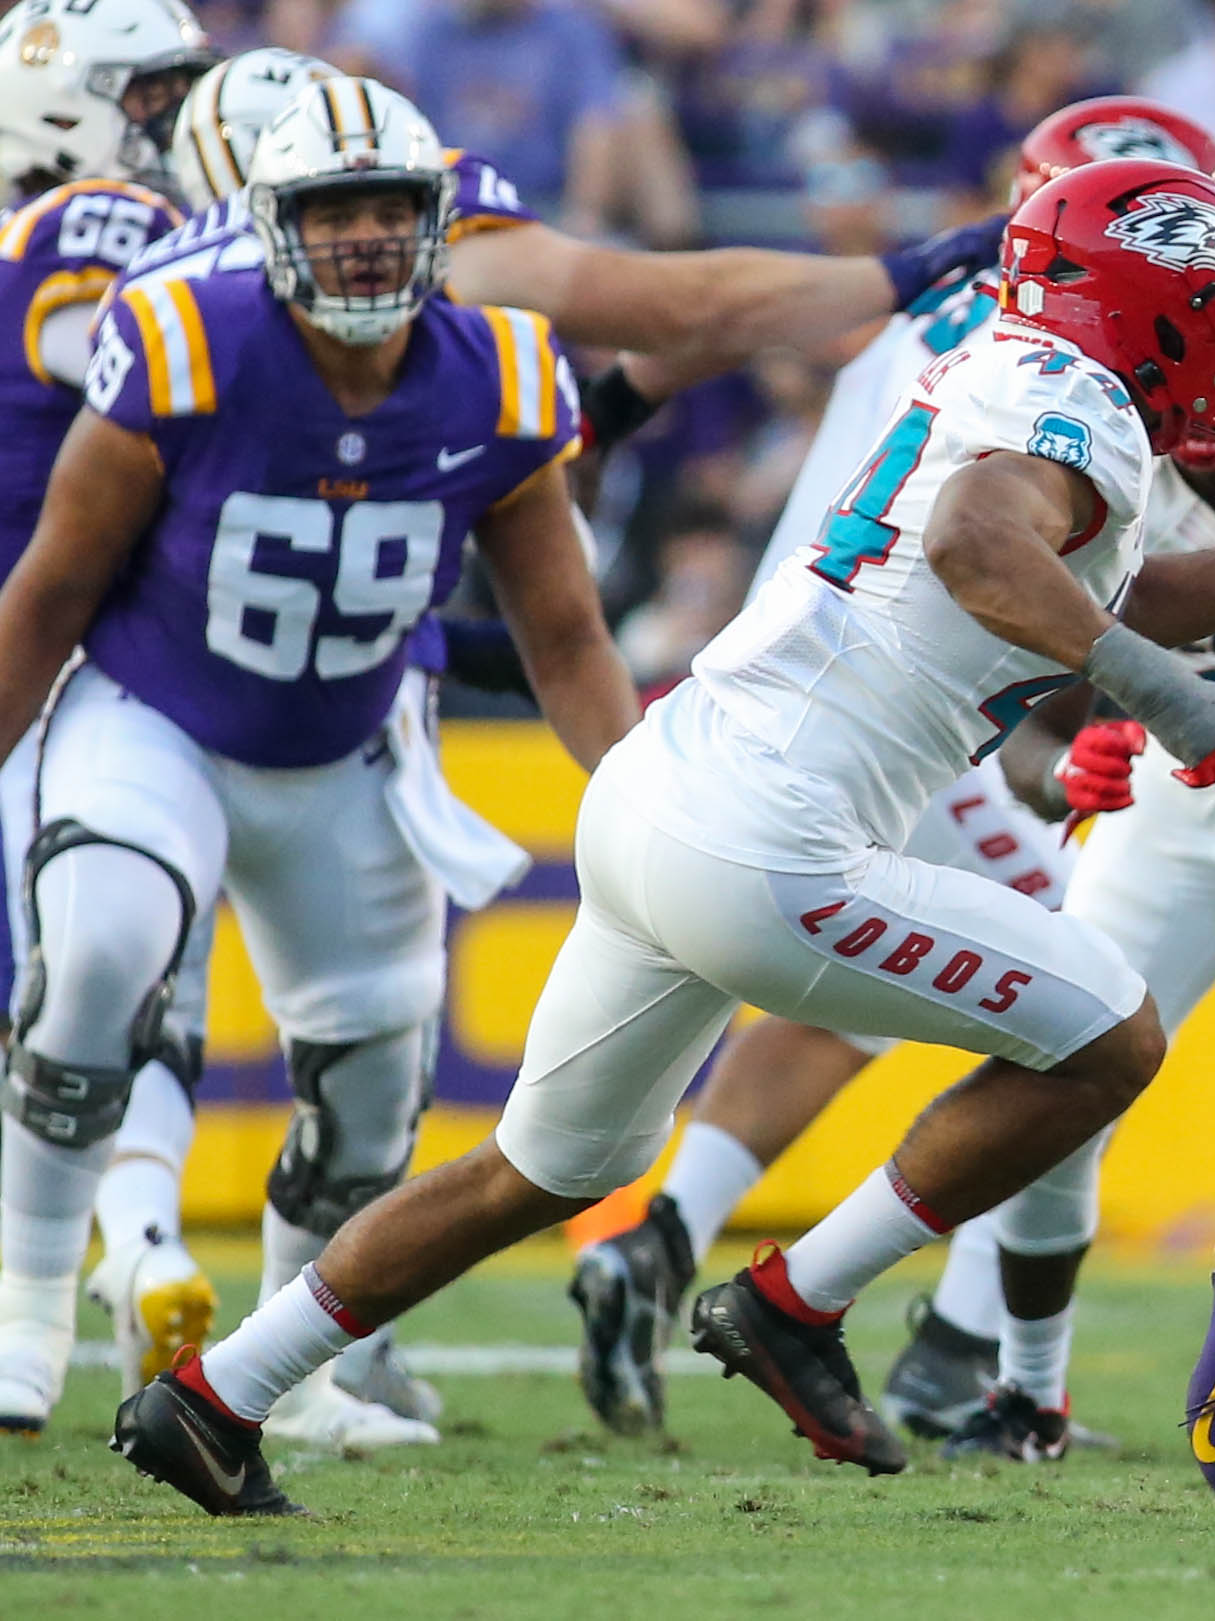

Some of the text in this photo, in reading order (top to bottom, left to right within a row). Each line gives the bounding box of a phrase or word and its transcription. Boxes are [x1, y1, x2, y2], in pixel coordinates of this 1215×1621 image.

[57, 194, 155, 268] 66
[206, 490, 445, 682] 69
[800, 901, 1033, 1013] LOBOS
